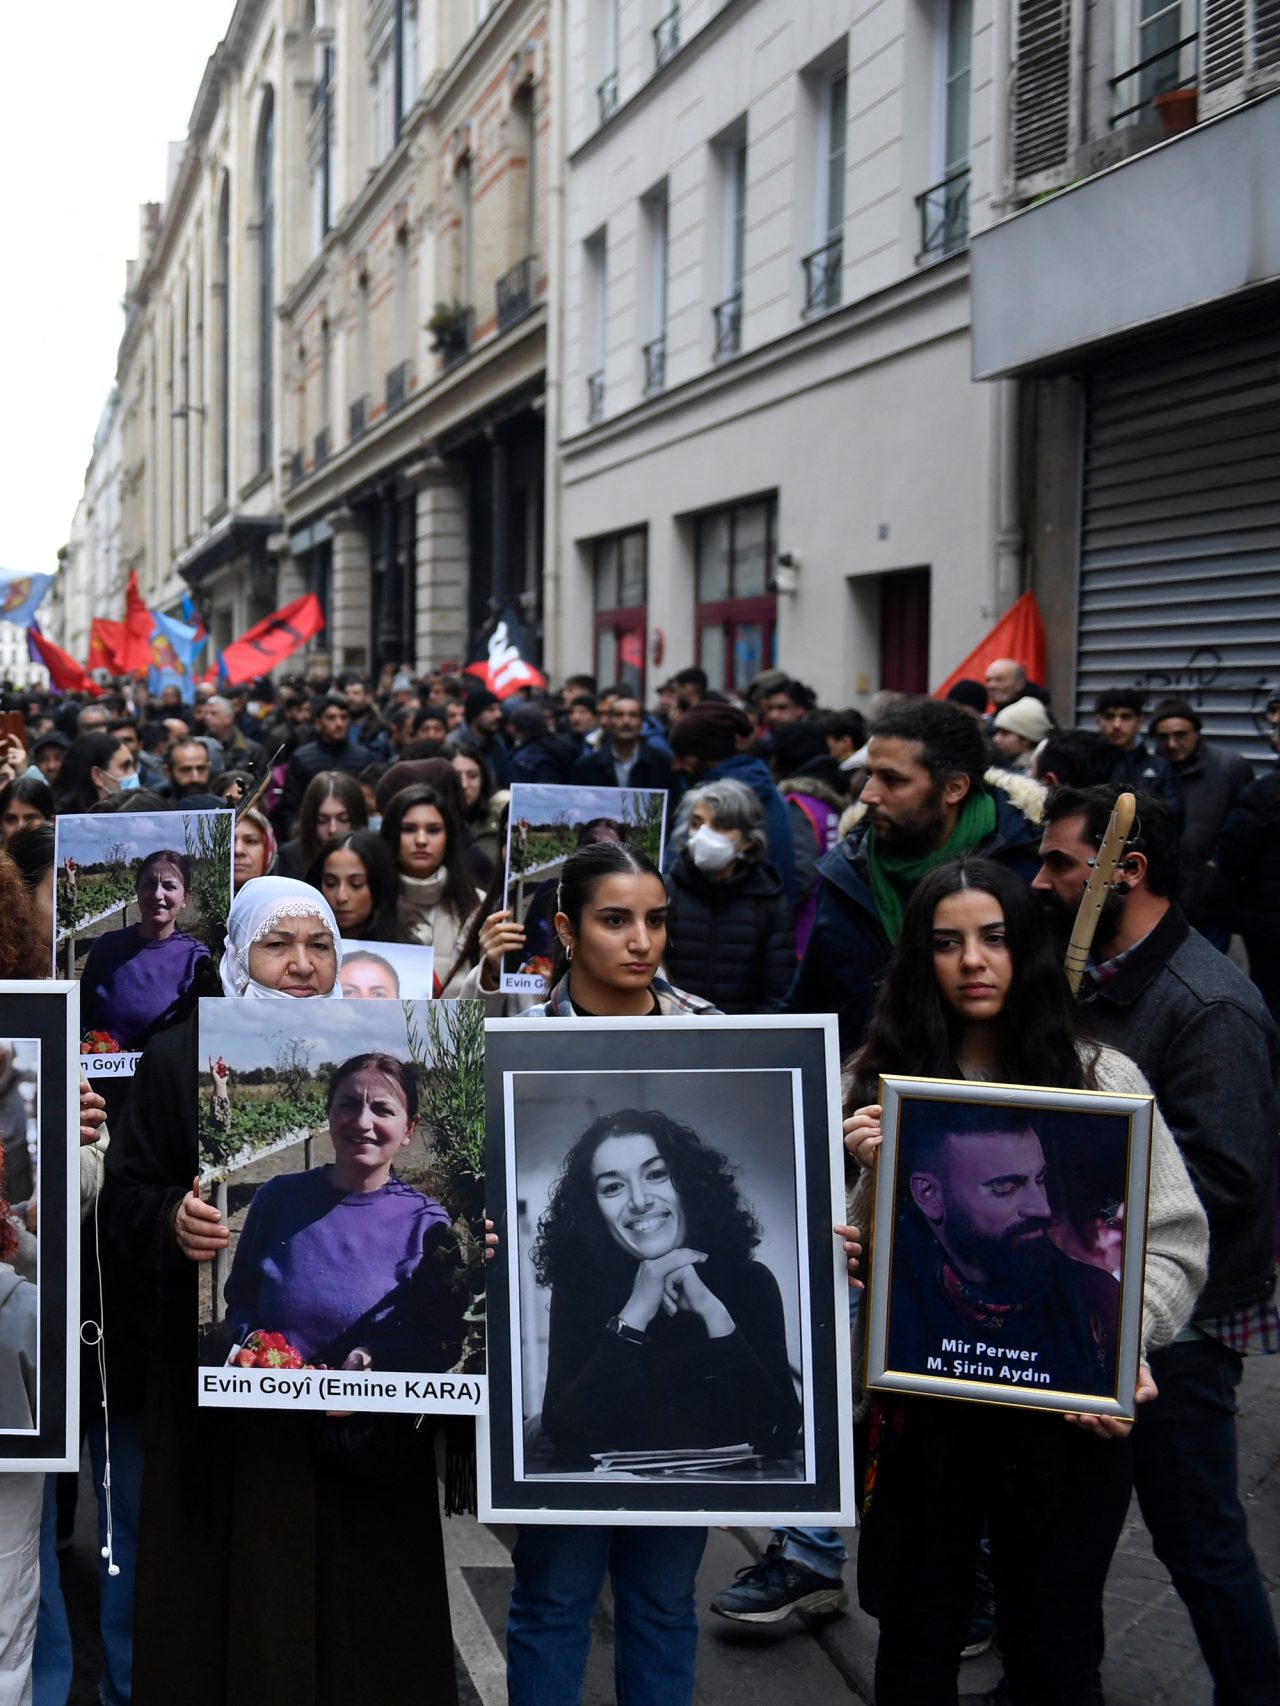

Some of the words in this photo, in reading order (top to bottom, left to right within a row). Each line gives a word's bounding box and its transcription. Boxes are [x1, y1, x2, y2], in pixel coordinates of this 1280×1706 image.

[506, 977, 531, 988] Evin
[93, 1057, 126, 1073] Goyî
[941, 1338, 971, 1354] Mîr
[976, 1342, 1038, 1362] Perwer
[926, 1356, 948, 1371] M.
[953, 1360, 994, 1377] Şirin
[999, 1365, 1050, 1384] Aydın
[203, 1375, 252, 1393] Evin
[259, 1376, 312, 1399] Goyî
[318, 1377, 397, 1401] (Emine
[405, 1381, 481, 1405] KARA)
